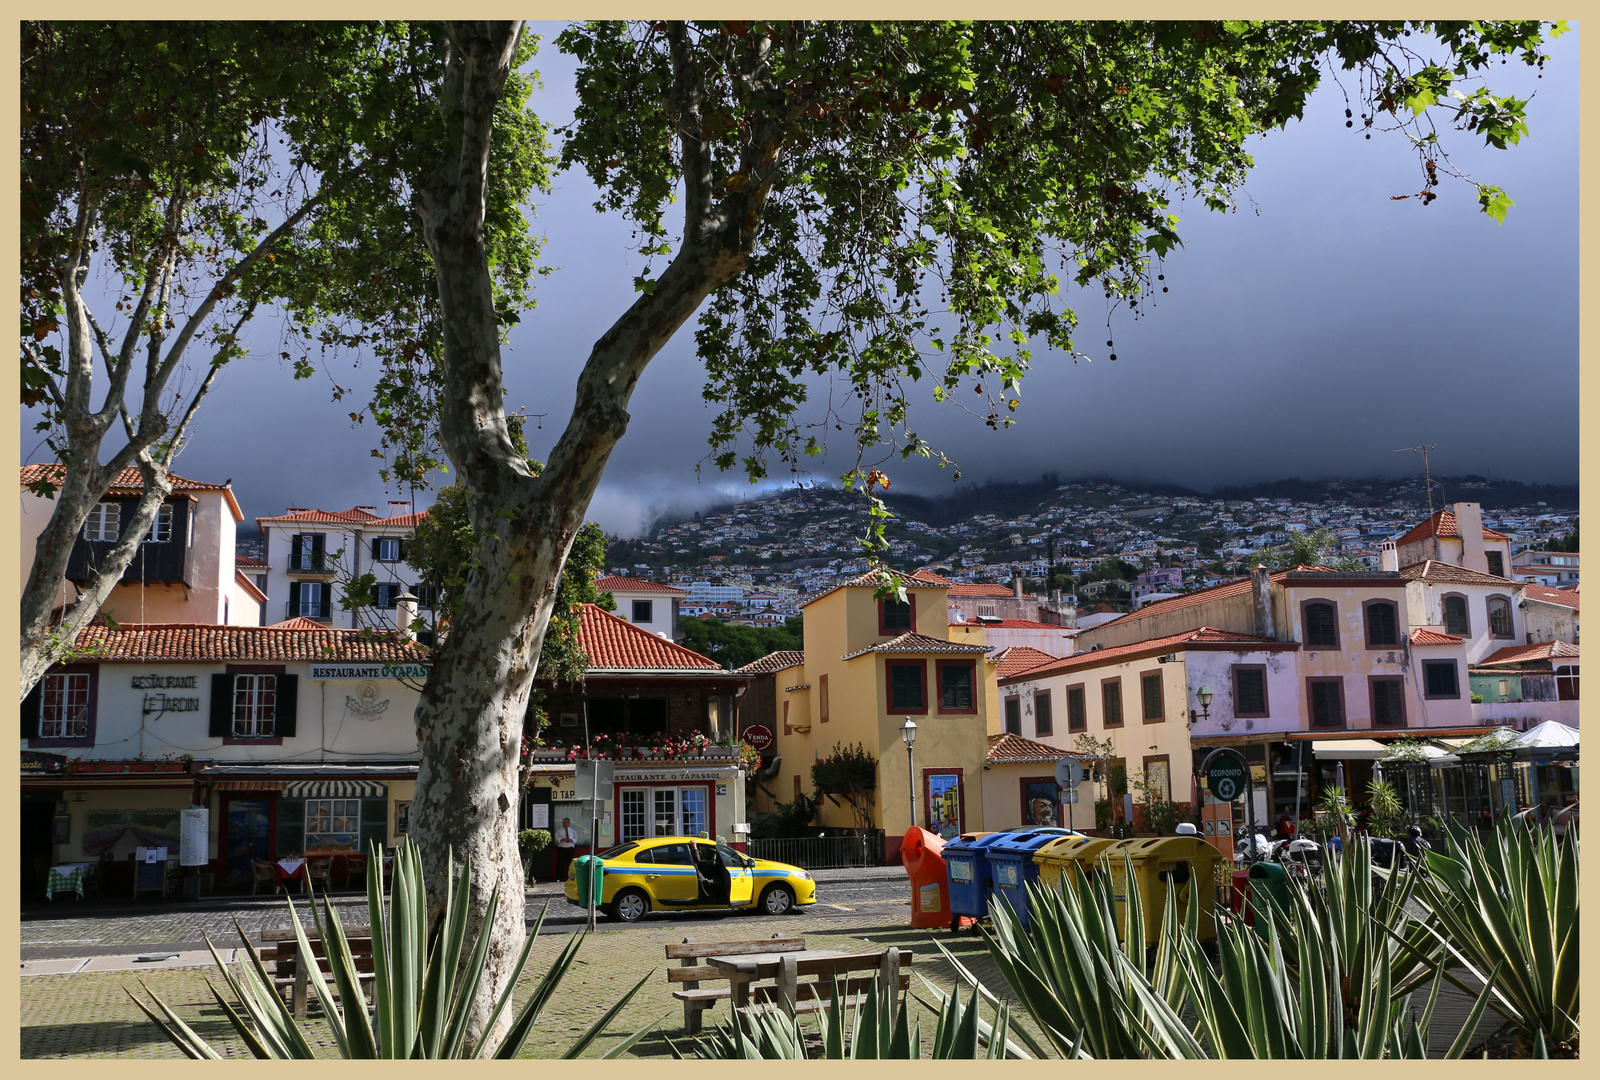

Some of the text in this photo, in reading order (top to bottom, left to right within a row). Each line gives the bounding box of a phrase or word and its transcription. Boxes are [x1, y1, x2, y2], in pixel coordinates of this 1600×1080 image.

[313, 668, 379, 678] RESTAURANTE
[381, 667, 389, 678] O
[131, 674, 198, 689] RESTAURANTE
[680, 772, 722, 780] TAPASSOL
[1210, 768, 1242, 777] ECOPONTO
[552, 790, 576, 799] O TAP
